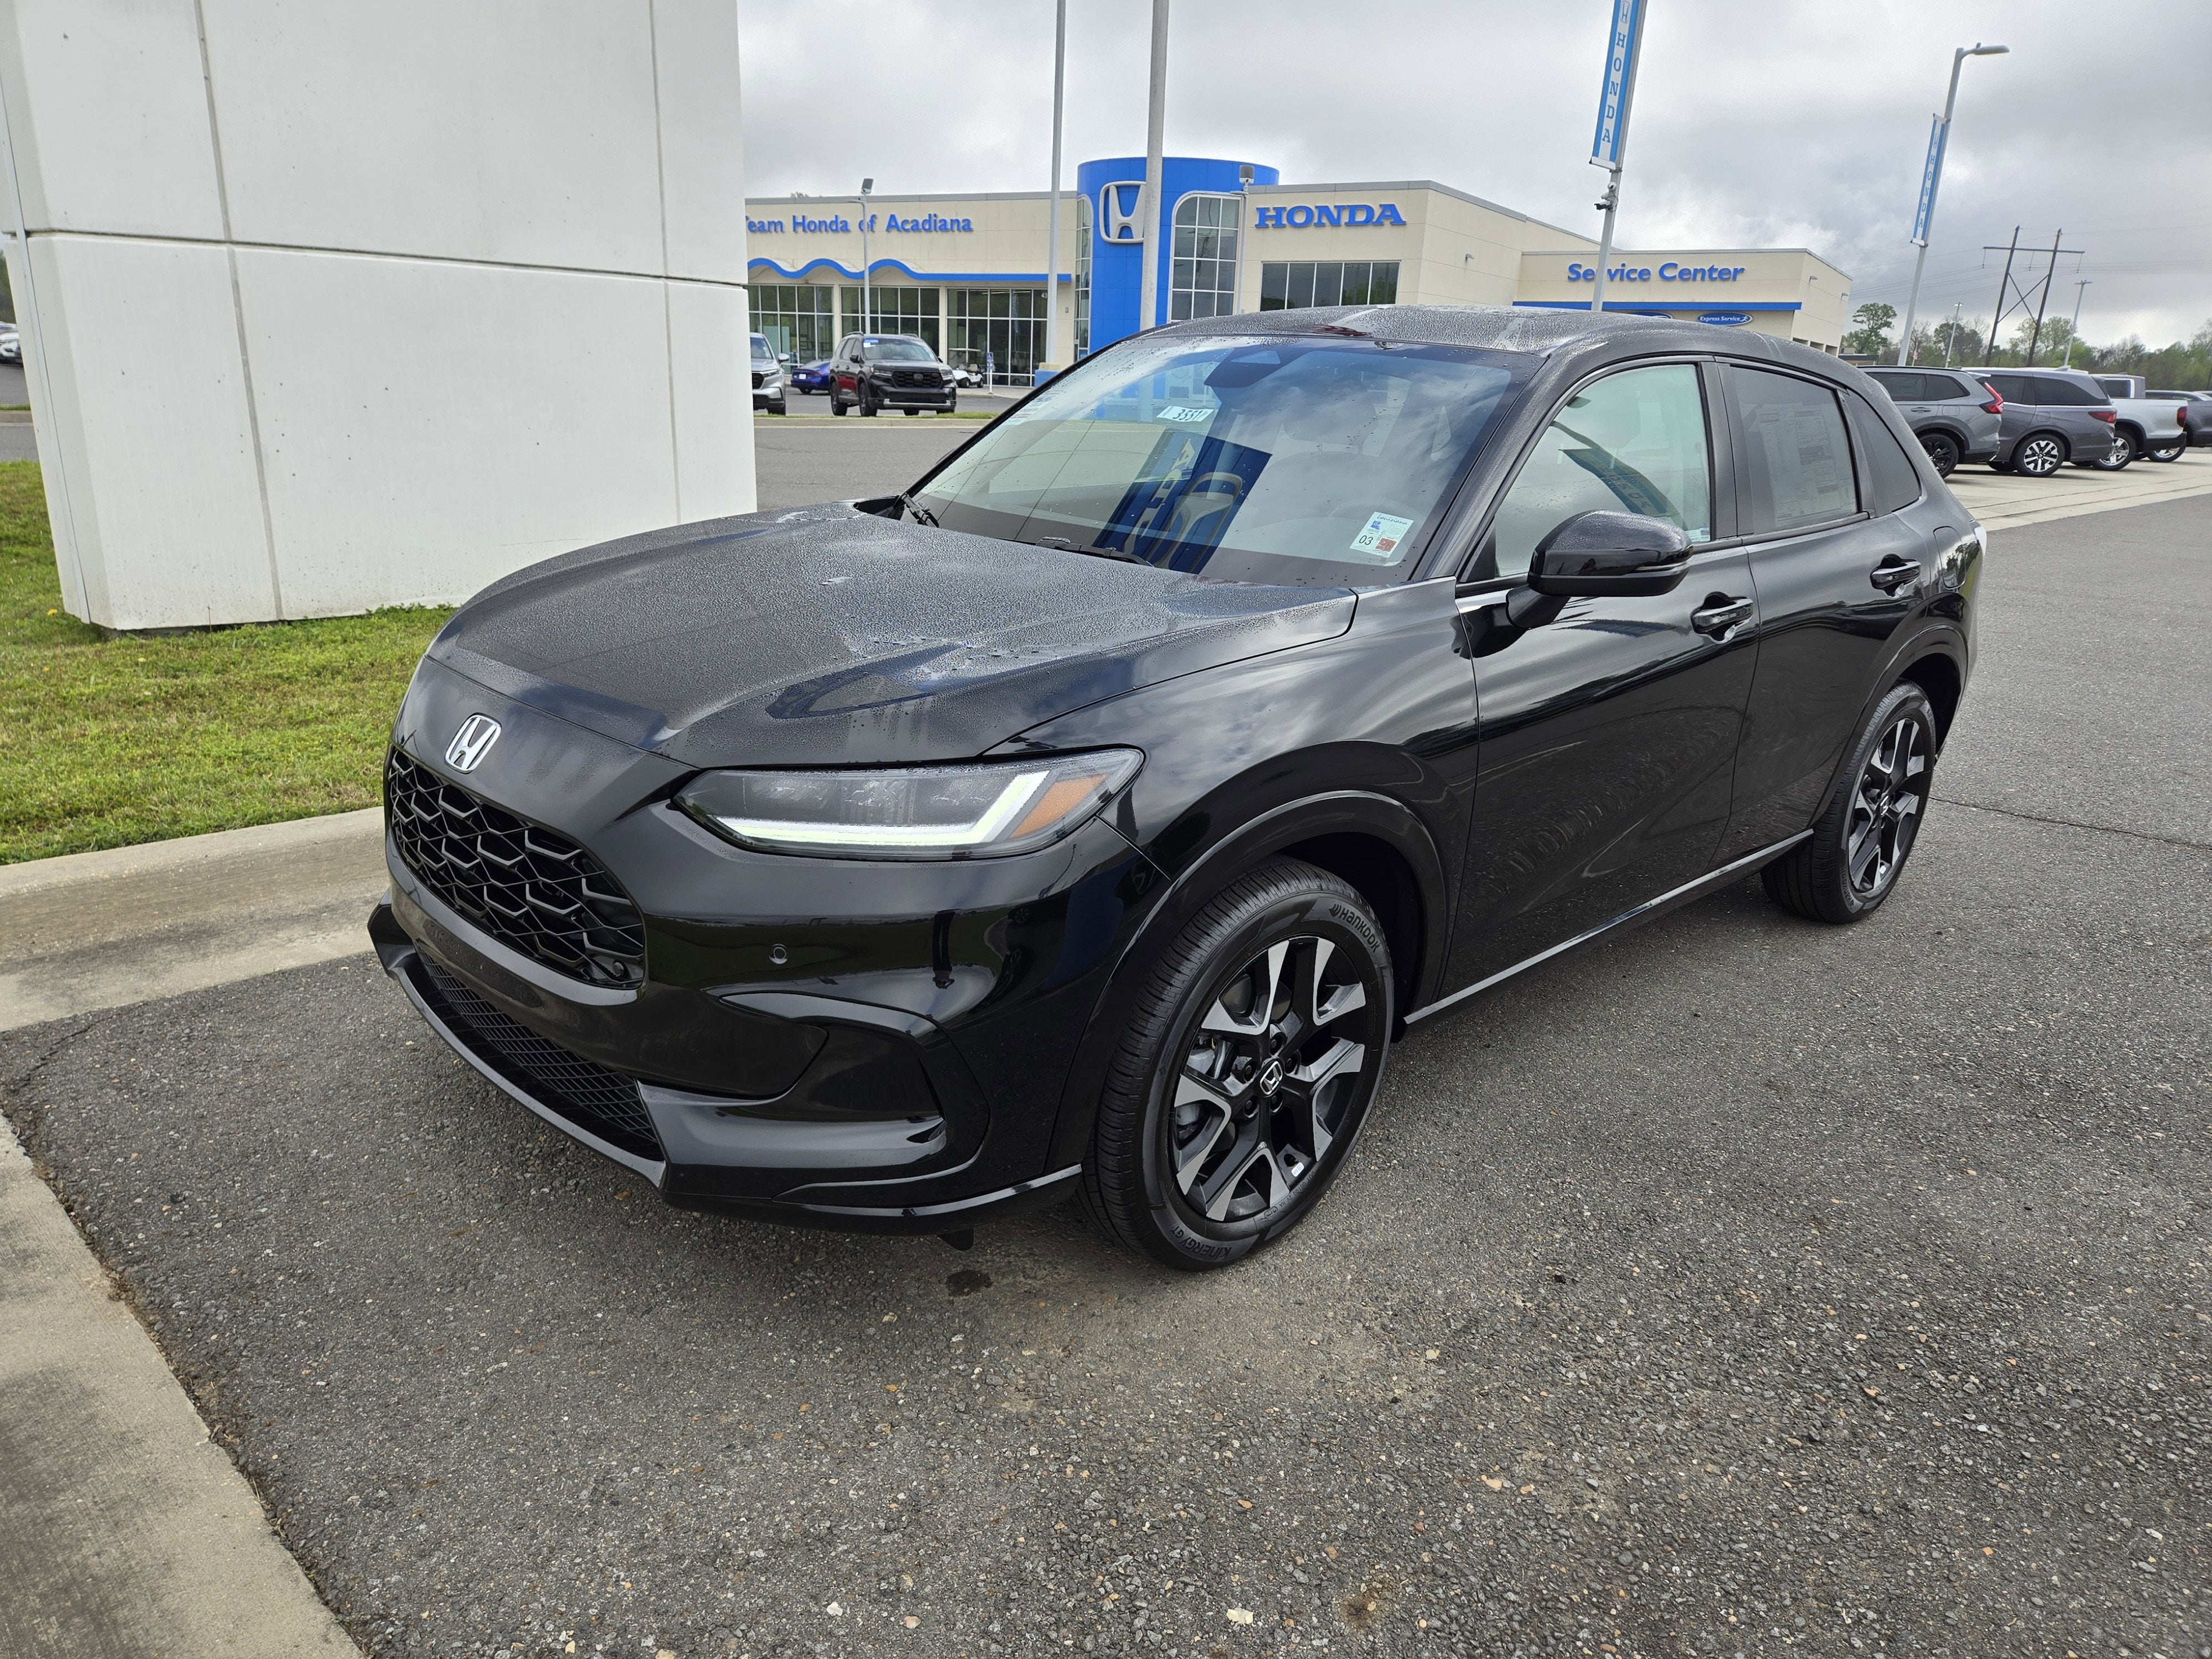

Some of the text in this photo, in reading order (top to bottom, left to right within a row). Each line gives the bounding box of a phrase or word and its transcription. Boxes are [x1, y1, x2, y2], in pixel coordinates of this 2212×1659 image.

[1601, 32, 1626, 143] HONDA
[1918, 155, 1936, 228] HONDA
[792, 215, 850, 233] Honda
[858, 214, 877, 233] of
[885, 213, 973, 233] Acadiana
[1255, 204, 1407, 228] HONDA
[1567, 262, 1745, 282] Sevice Center
[1376, 514, 1407, 525] Louisiana
[1359, 535, 1374, 545] 03
[1171, 1225, 1232, 1258] KINERGY GT
